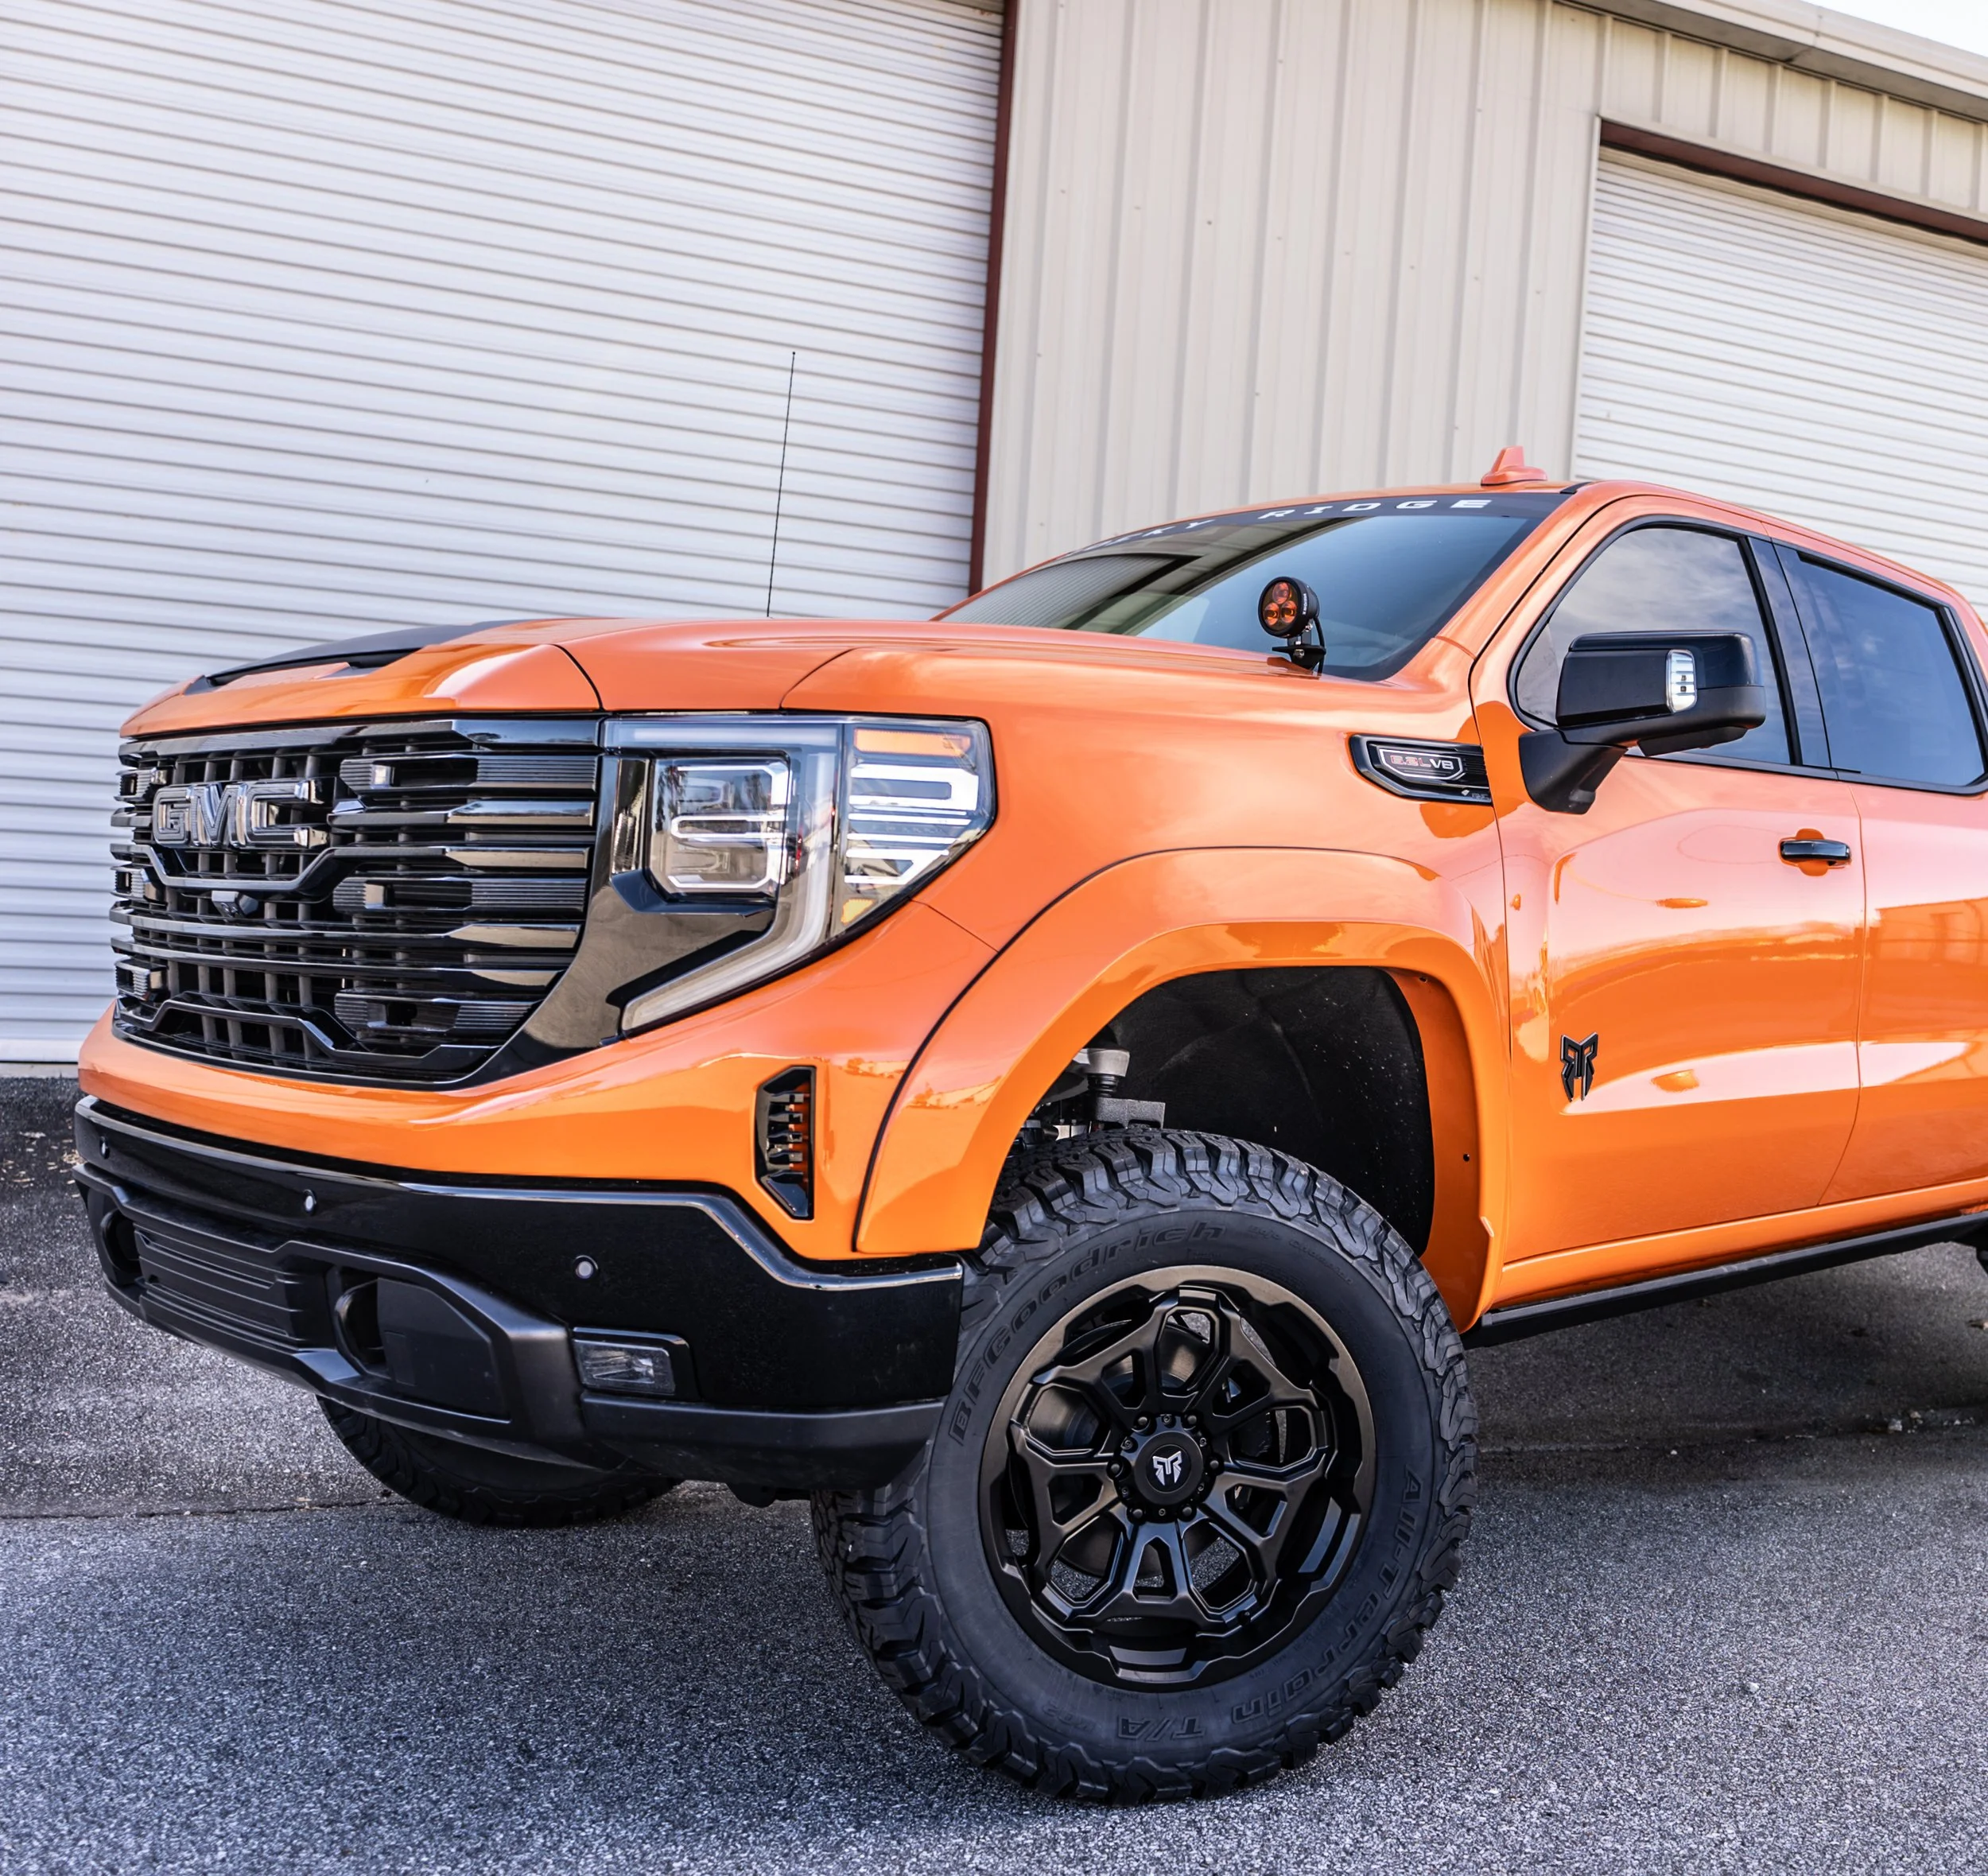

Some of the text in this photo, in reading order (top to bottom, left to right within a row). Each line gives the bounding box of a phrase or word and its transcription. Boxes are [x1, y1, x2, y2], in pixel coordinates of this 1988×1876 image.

[1257, 499, 1492, 519] RIDGE
[153, 780, 328, 849] GMC
[949, 1222, 1226, 1446] BFGoodrich
[1117, 1714, 1207, 1742] T/A
